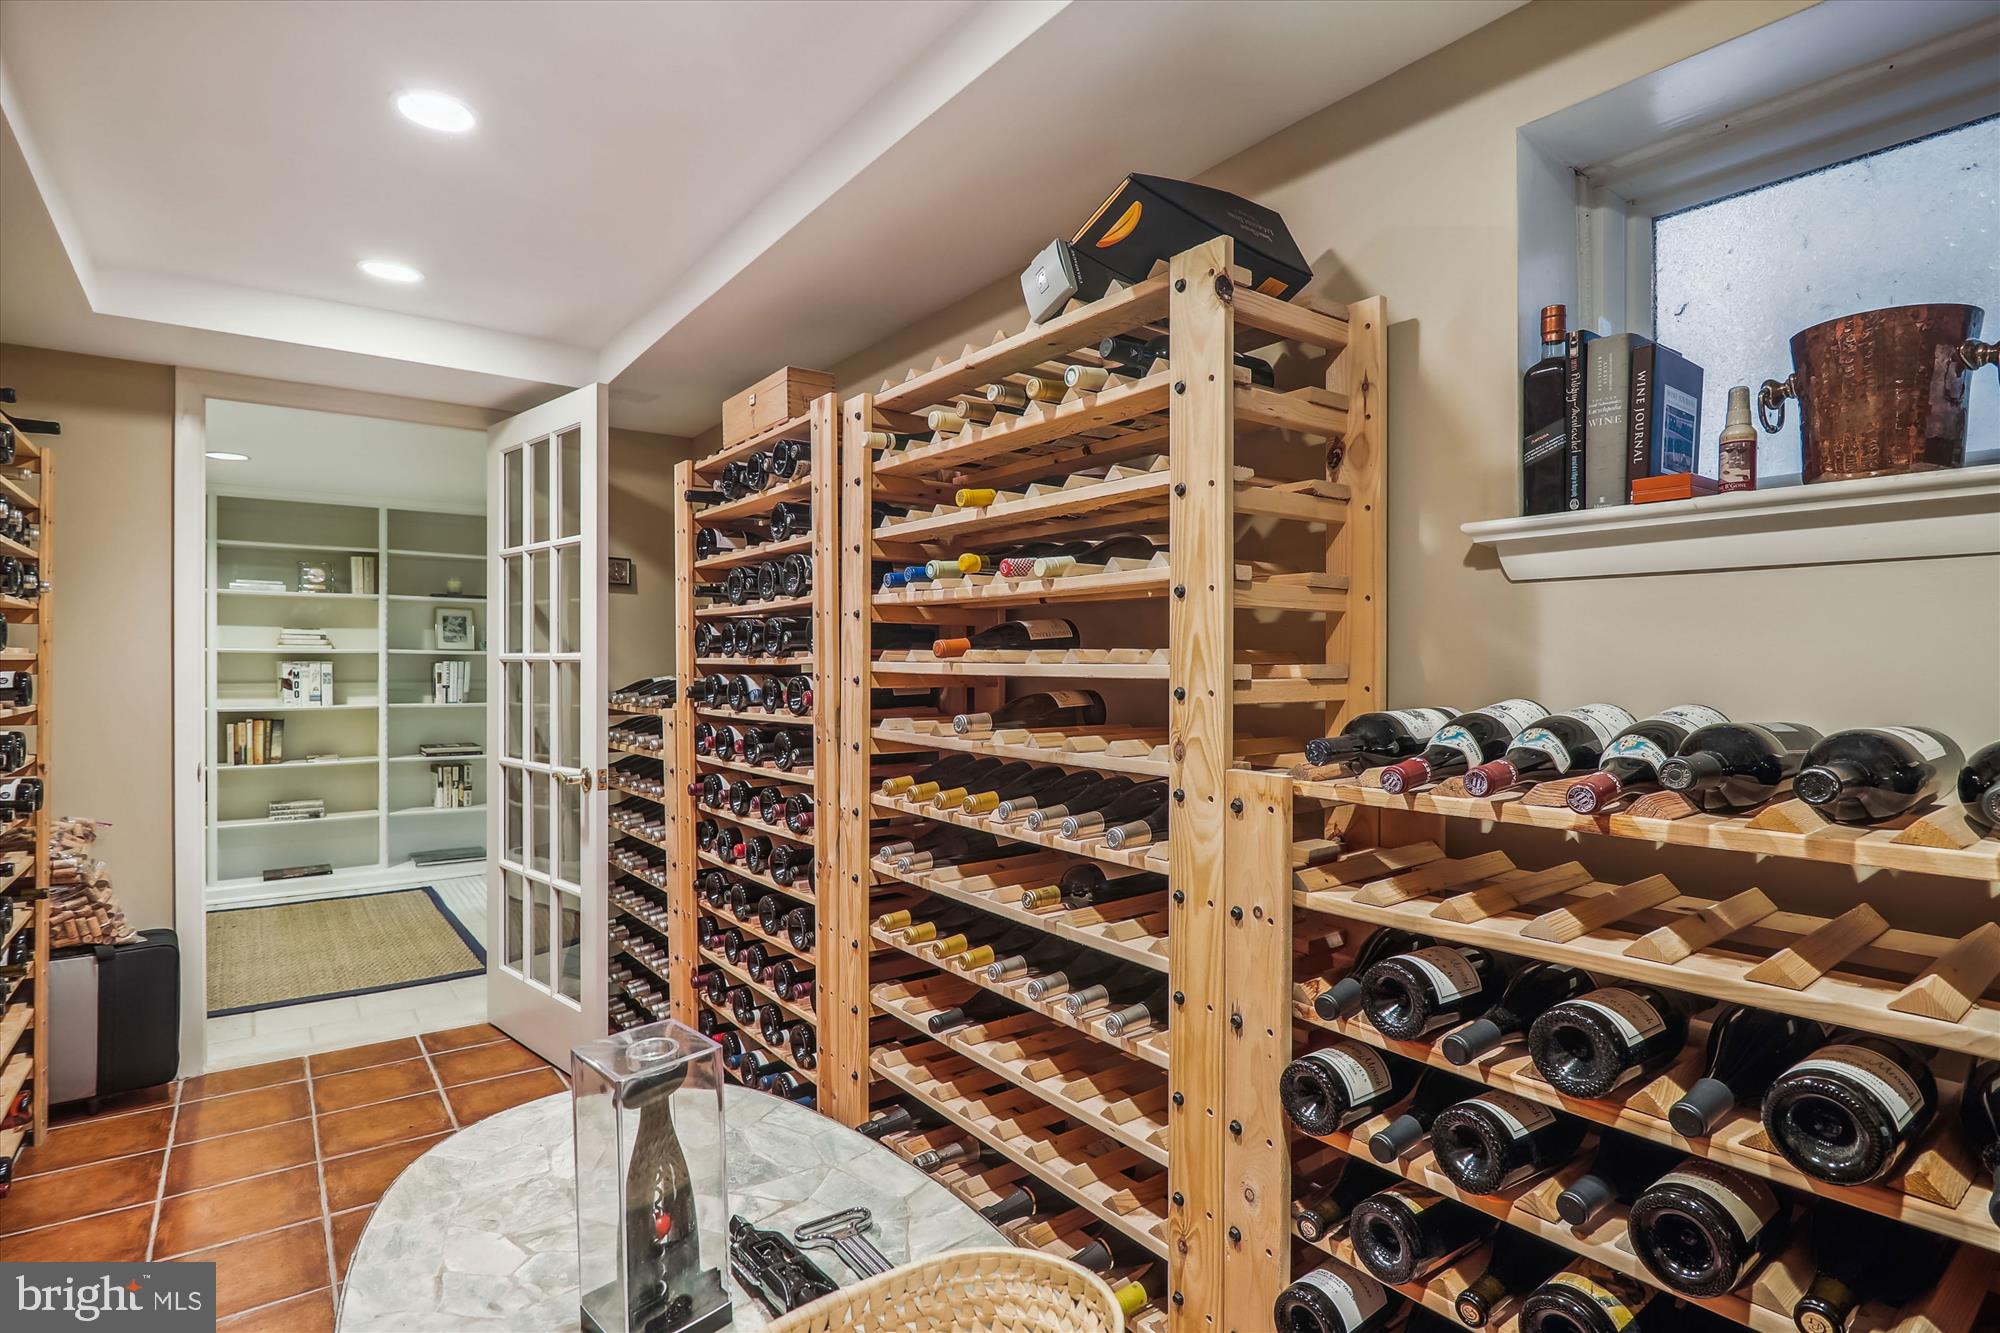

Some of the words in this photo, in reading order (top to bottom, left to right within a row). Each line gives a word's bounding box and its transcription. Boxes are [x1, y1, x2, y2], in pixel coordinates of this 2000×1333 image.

[1636, 370, 1647, 404] WINE
[1588, 414, 1623, 428] WINE
[1633, 407, 1645, 465] JOURNAL
[292, 671, 300, 699] MOO
